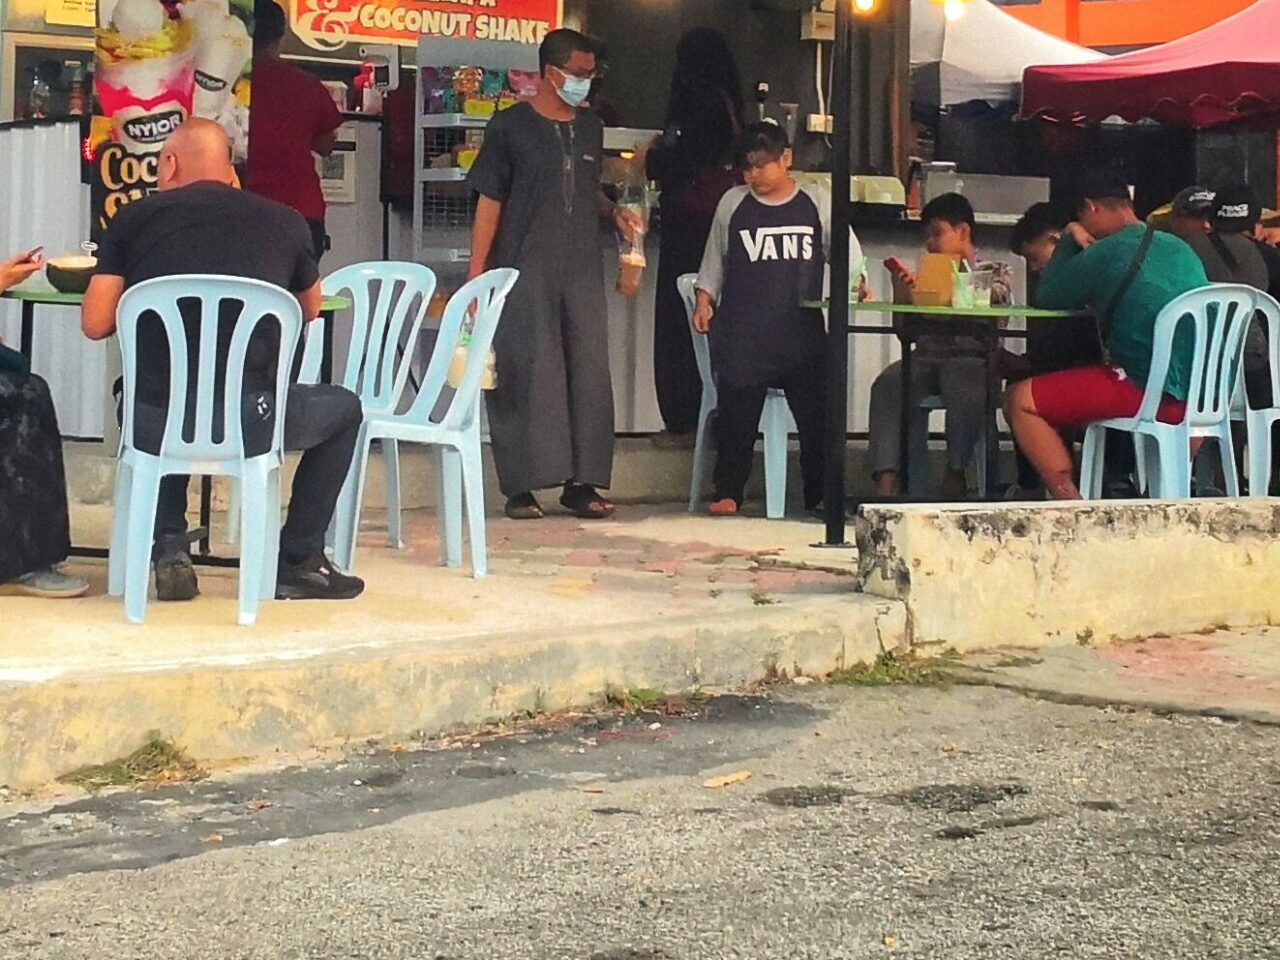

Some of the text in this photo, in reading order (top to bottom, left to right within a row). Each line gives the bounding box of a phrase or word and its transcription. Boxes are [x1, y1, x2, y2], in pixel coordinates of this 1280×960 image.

[359, 3, 471, 37] COCONUT
[475, 14, 549, 44] SHAKE
[127, 113, 182, 138] NYIOR
[739, 225, 814, 263] VANS
